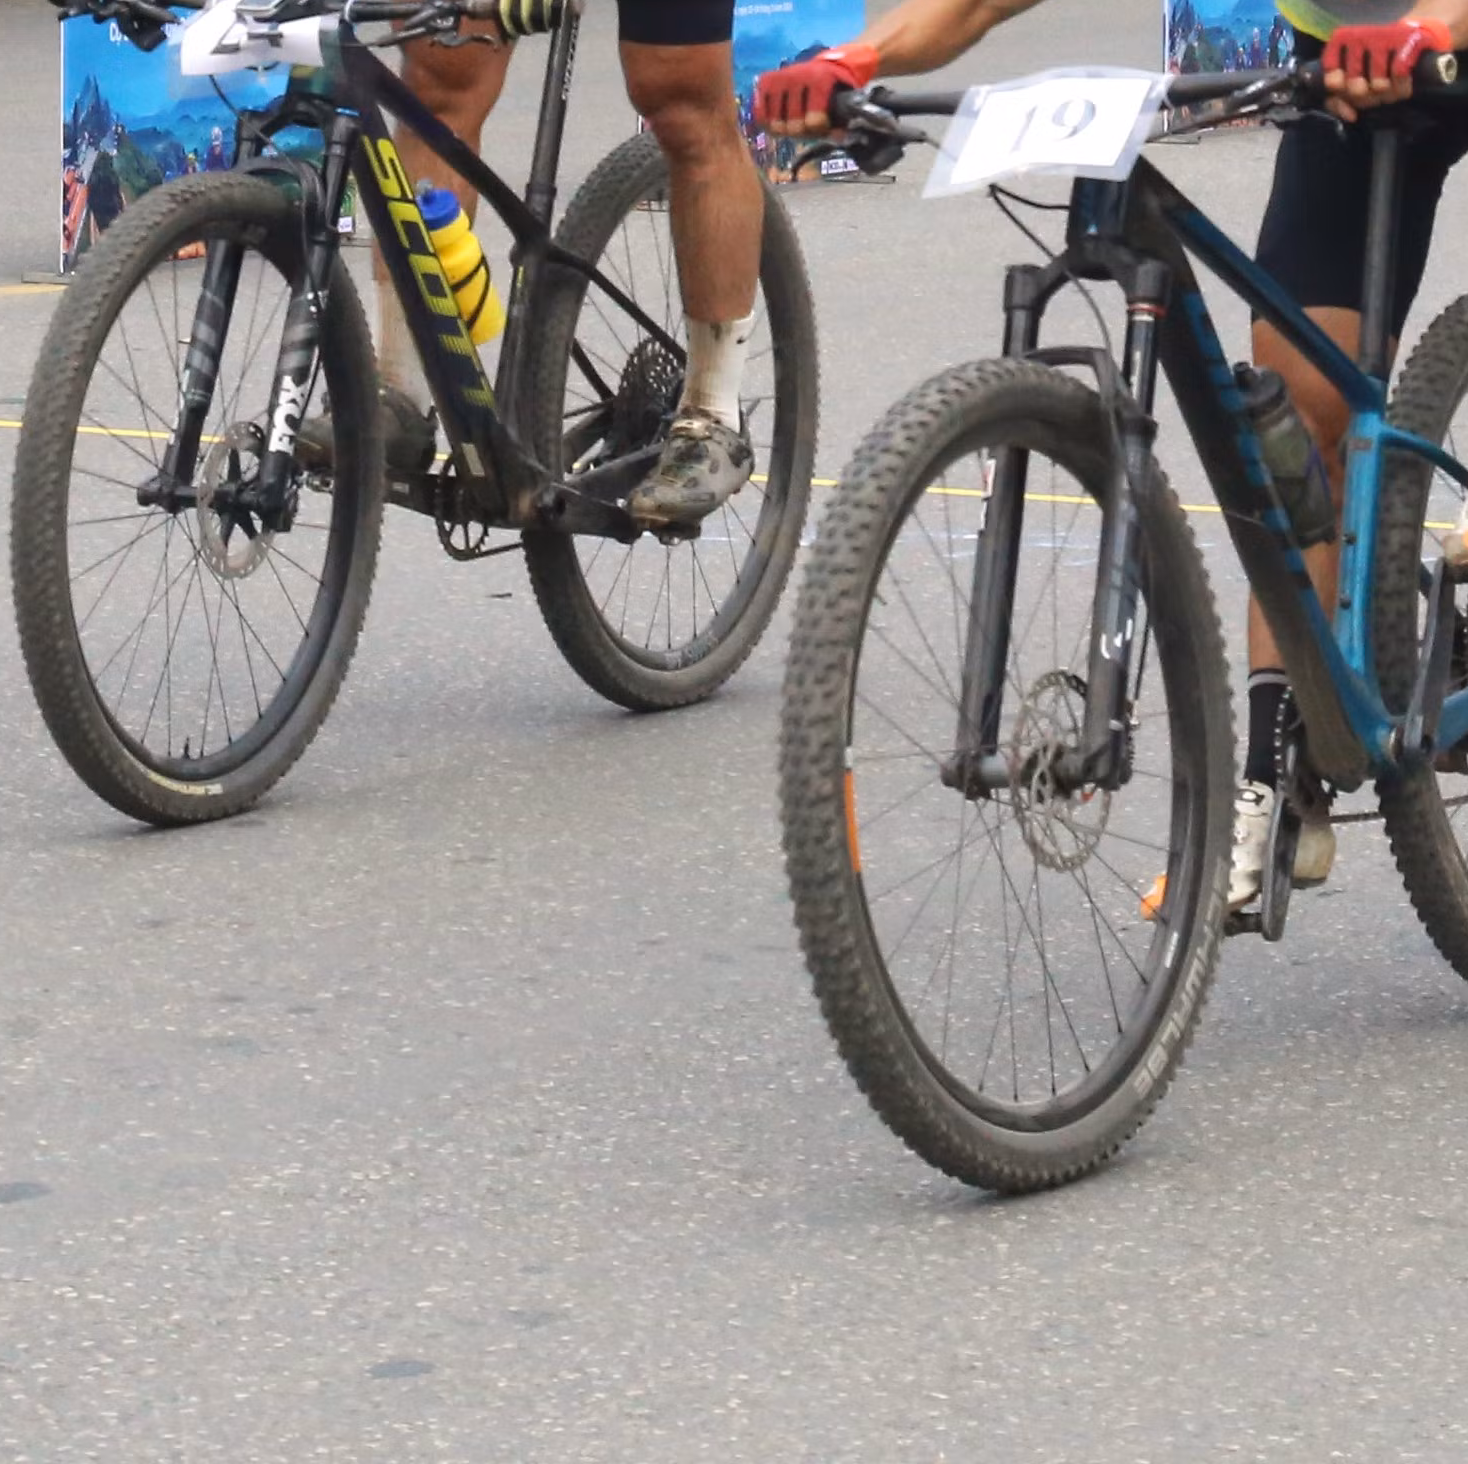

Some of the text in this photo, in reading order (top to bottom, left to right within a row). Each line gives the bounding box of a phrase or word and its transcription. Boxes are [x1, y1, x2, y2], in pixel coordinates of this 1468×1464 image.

[1008, 98, 1097, 154] 19
[361, 134, 497, 409] SCOTT
[268, 375, 310, 456] FOX
